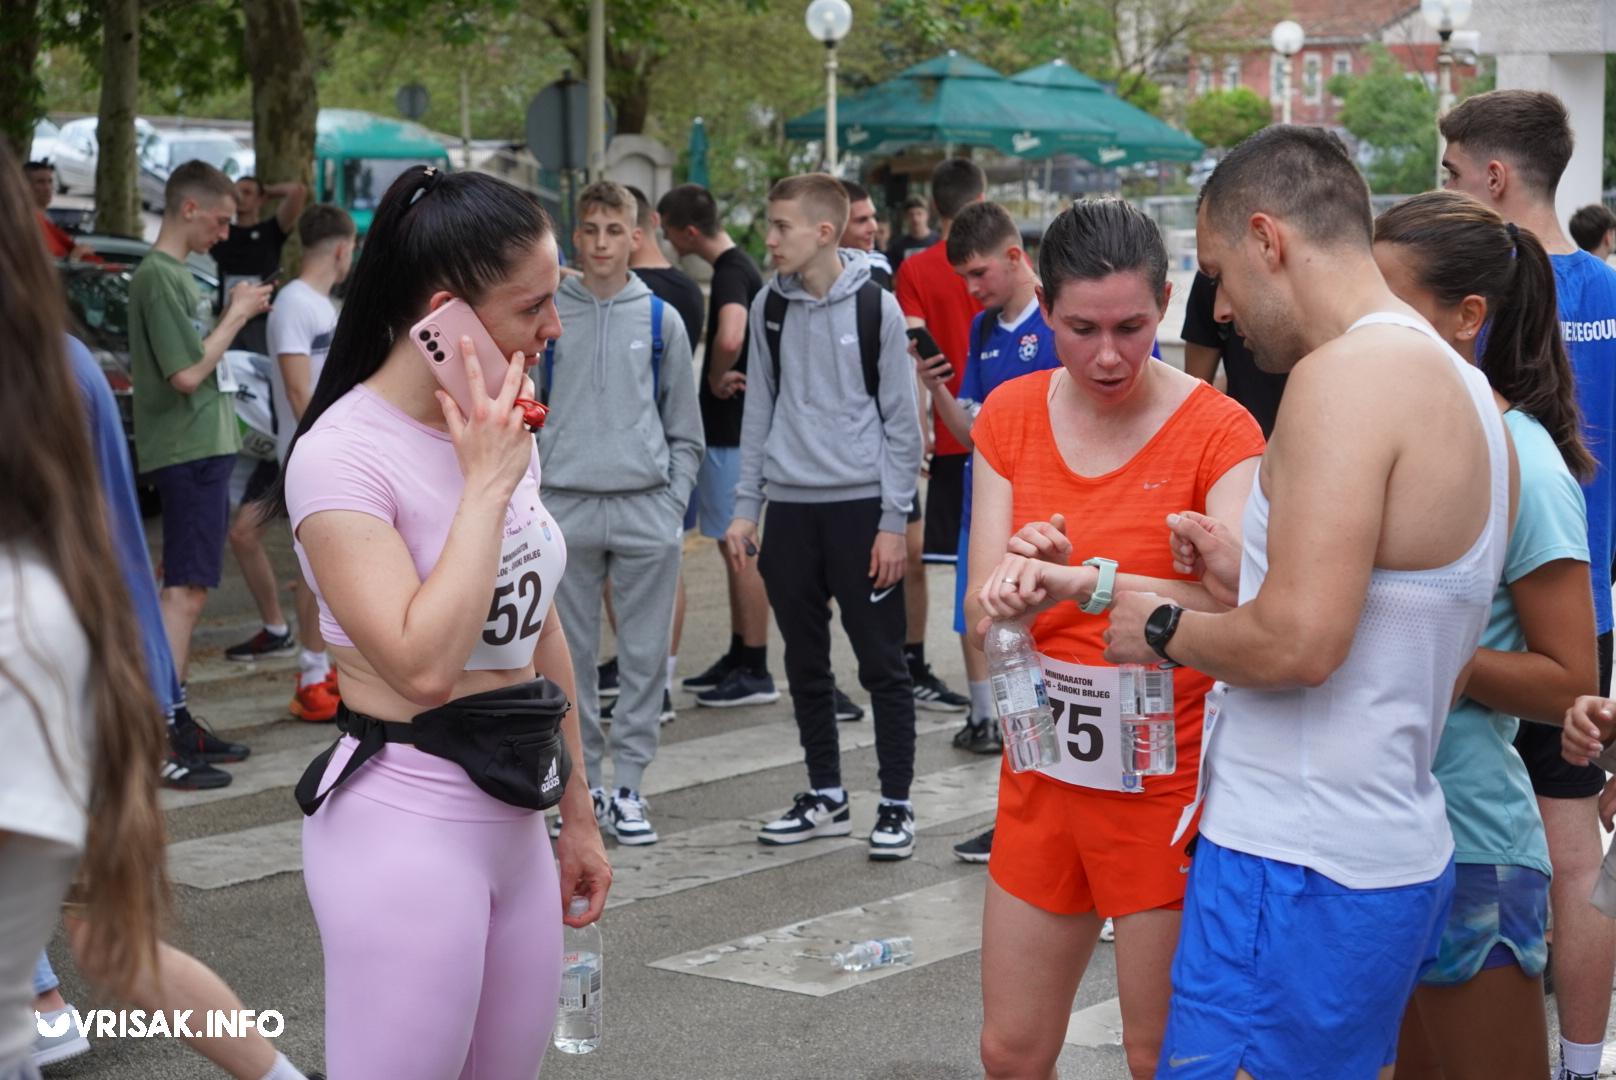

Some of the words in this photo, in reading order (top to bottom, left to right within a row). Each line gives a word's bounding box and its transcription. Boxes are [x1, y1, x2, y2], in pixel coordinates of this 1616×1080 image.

[482, 570, 542, 646] 52
[1045, 668, 1093, 687] MINIMARATON
[1057, 682, 1080, 696] ŠIROKI
[1082, 689, 1110, 699] BRIJEG
